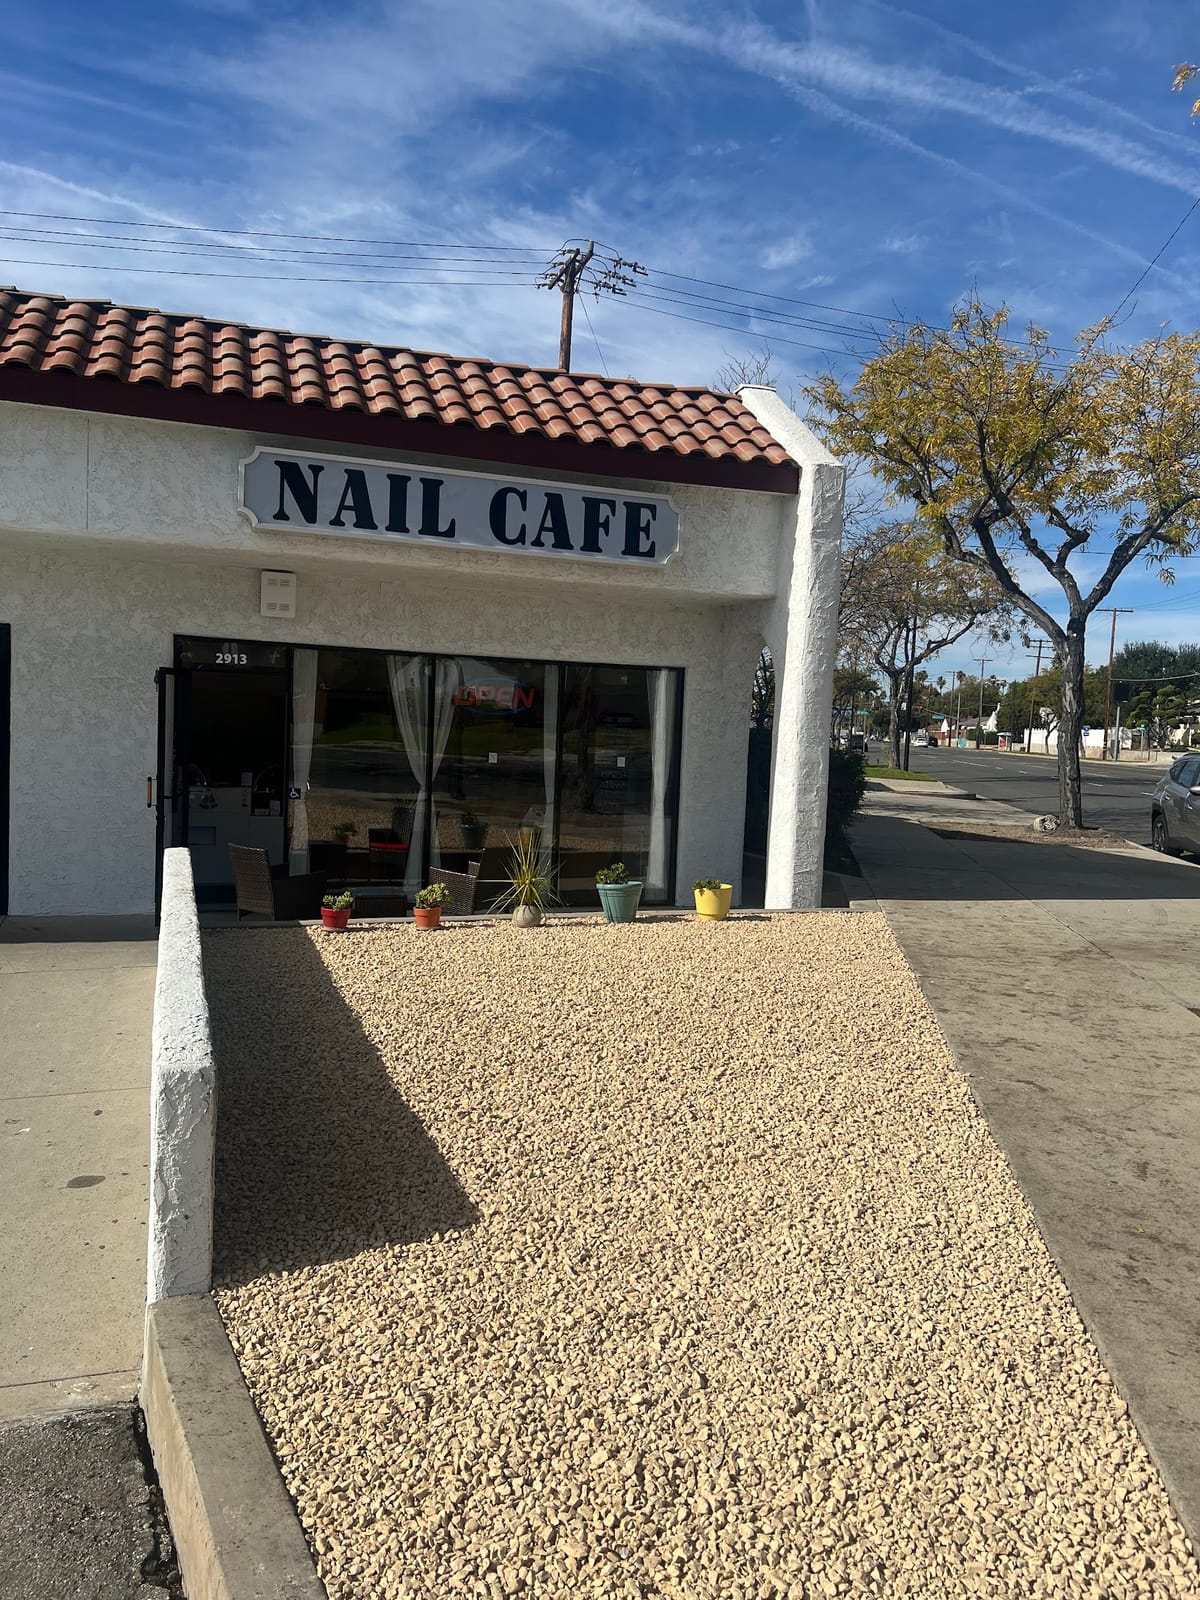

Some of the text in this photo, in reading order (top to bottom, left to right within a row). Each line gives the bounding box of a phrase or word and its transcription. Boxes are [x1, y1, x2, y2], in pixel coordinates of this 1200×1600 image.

[273, 460, 657, 558] NAIL CAFE
[215, 653, 248, 665] 2913
[453, 685, 535, 709] OPEN
